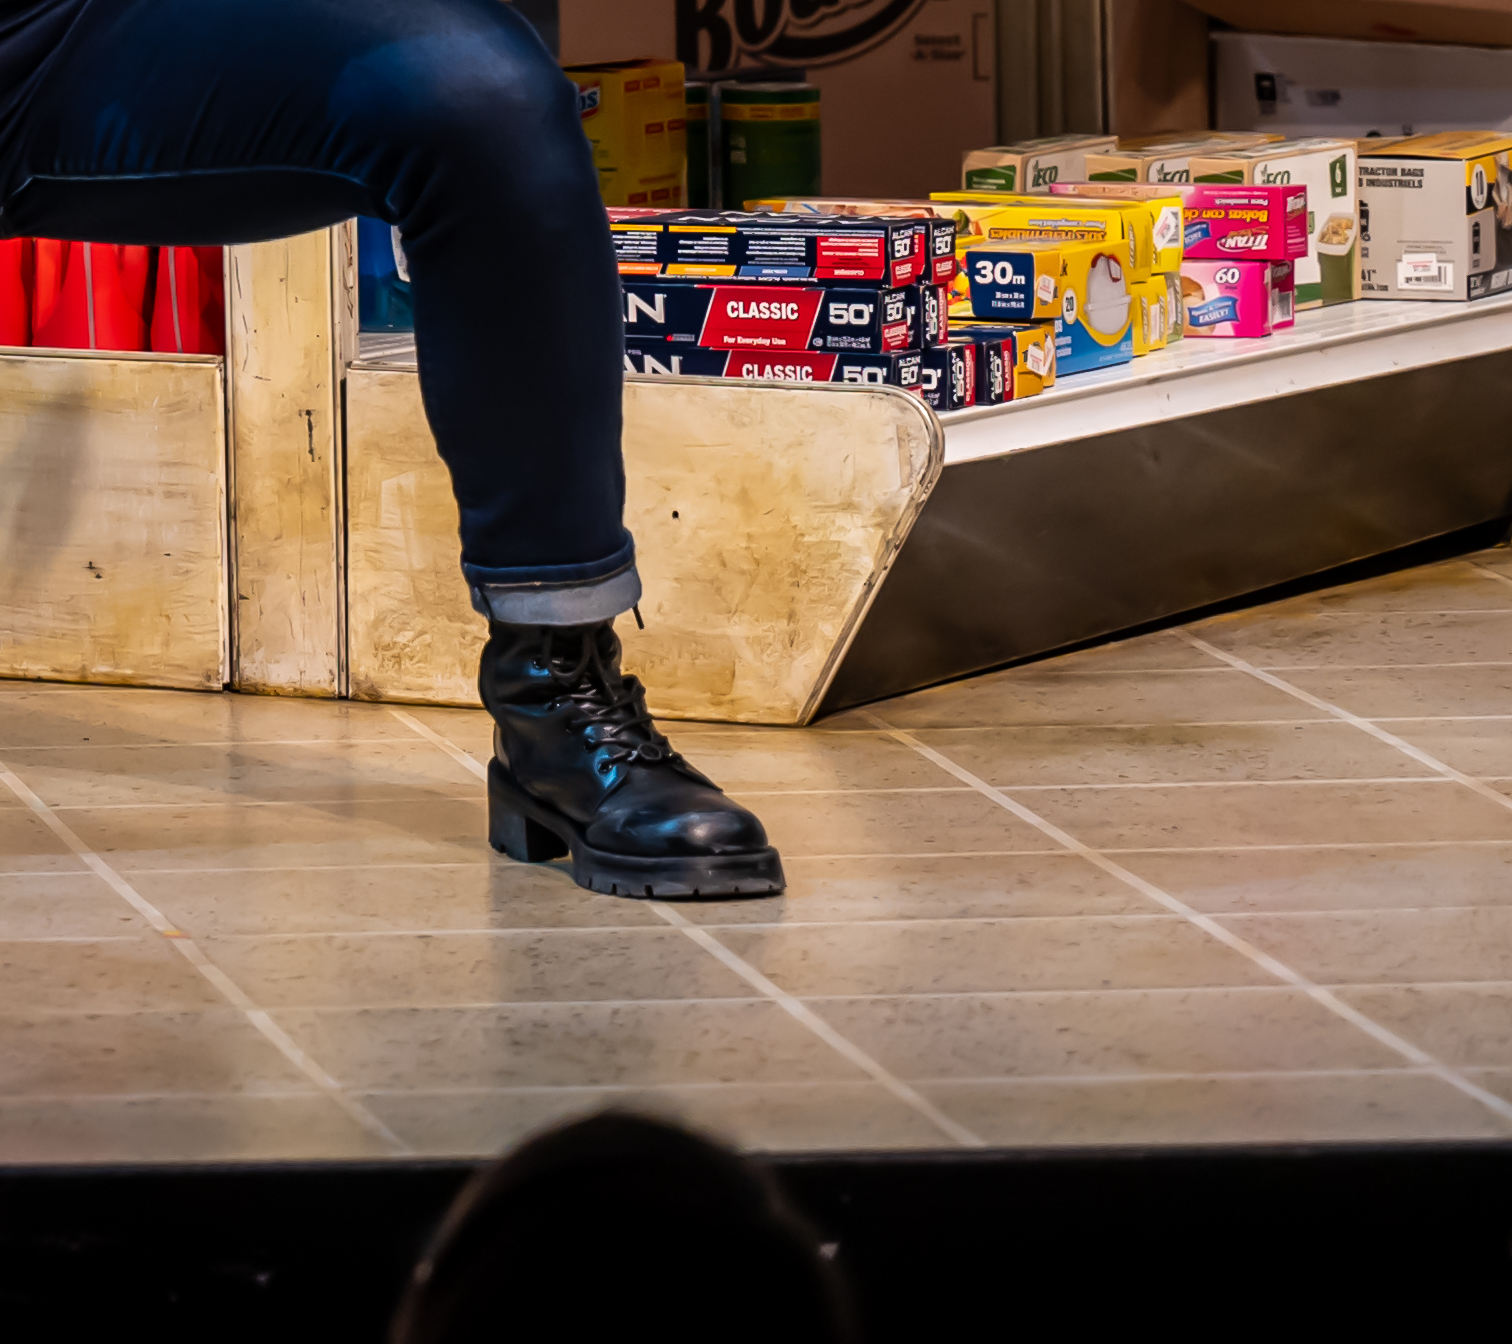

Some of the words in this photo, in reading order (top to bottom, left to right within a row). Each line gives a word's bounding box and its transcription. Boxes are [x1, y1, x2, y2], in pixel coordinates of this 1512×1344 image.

[1359, 166, 1397, 177] TRACTOR
[891, 228, 914, 240] ALCAN
[932, 226, 955, 239] ALCAN
[894, 239, 913, 257] 50'
[934, 237, 953, 255] 50'
[1214, 268, 1240, 284] 60
[884, 292, 906, 305] ALCAN
[726, 301, 799, 322] CLASSIC
[828, 302, 874, 326] 50'
[886, 304, 905, 321] 50'
[723, 335, 741, 346] For
[742, 335, 769, 348] Everyday
[770, 336, 786, 347] Use
[898, 355, 921, 368] ALCAN
[741, 364, 813, 382] CLASSIC
[900, 367, 919, 385] 50'
